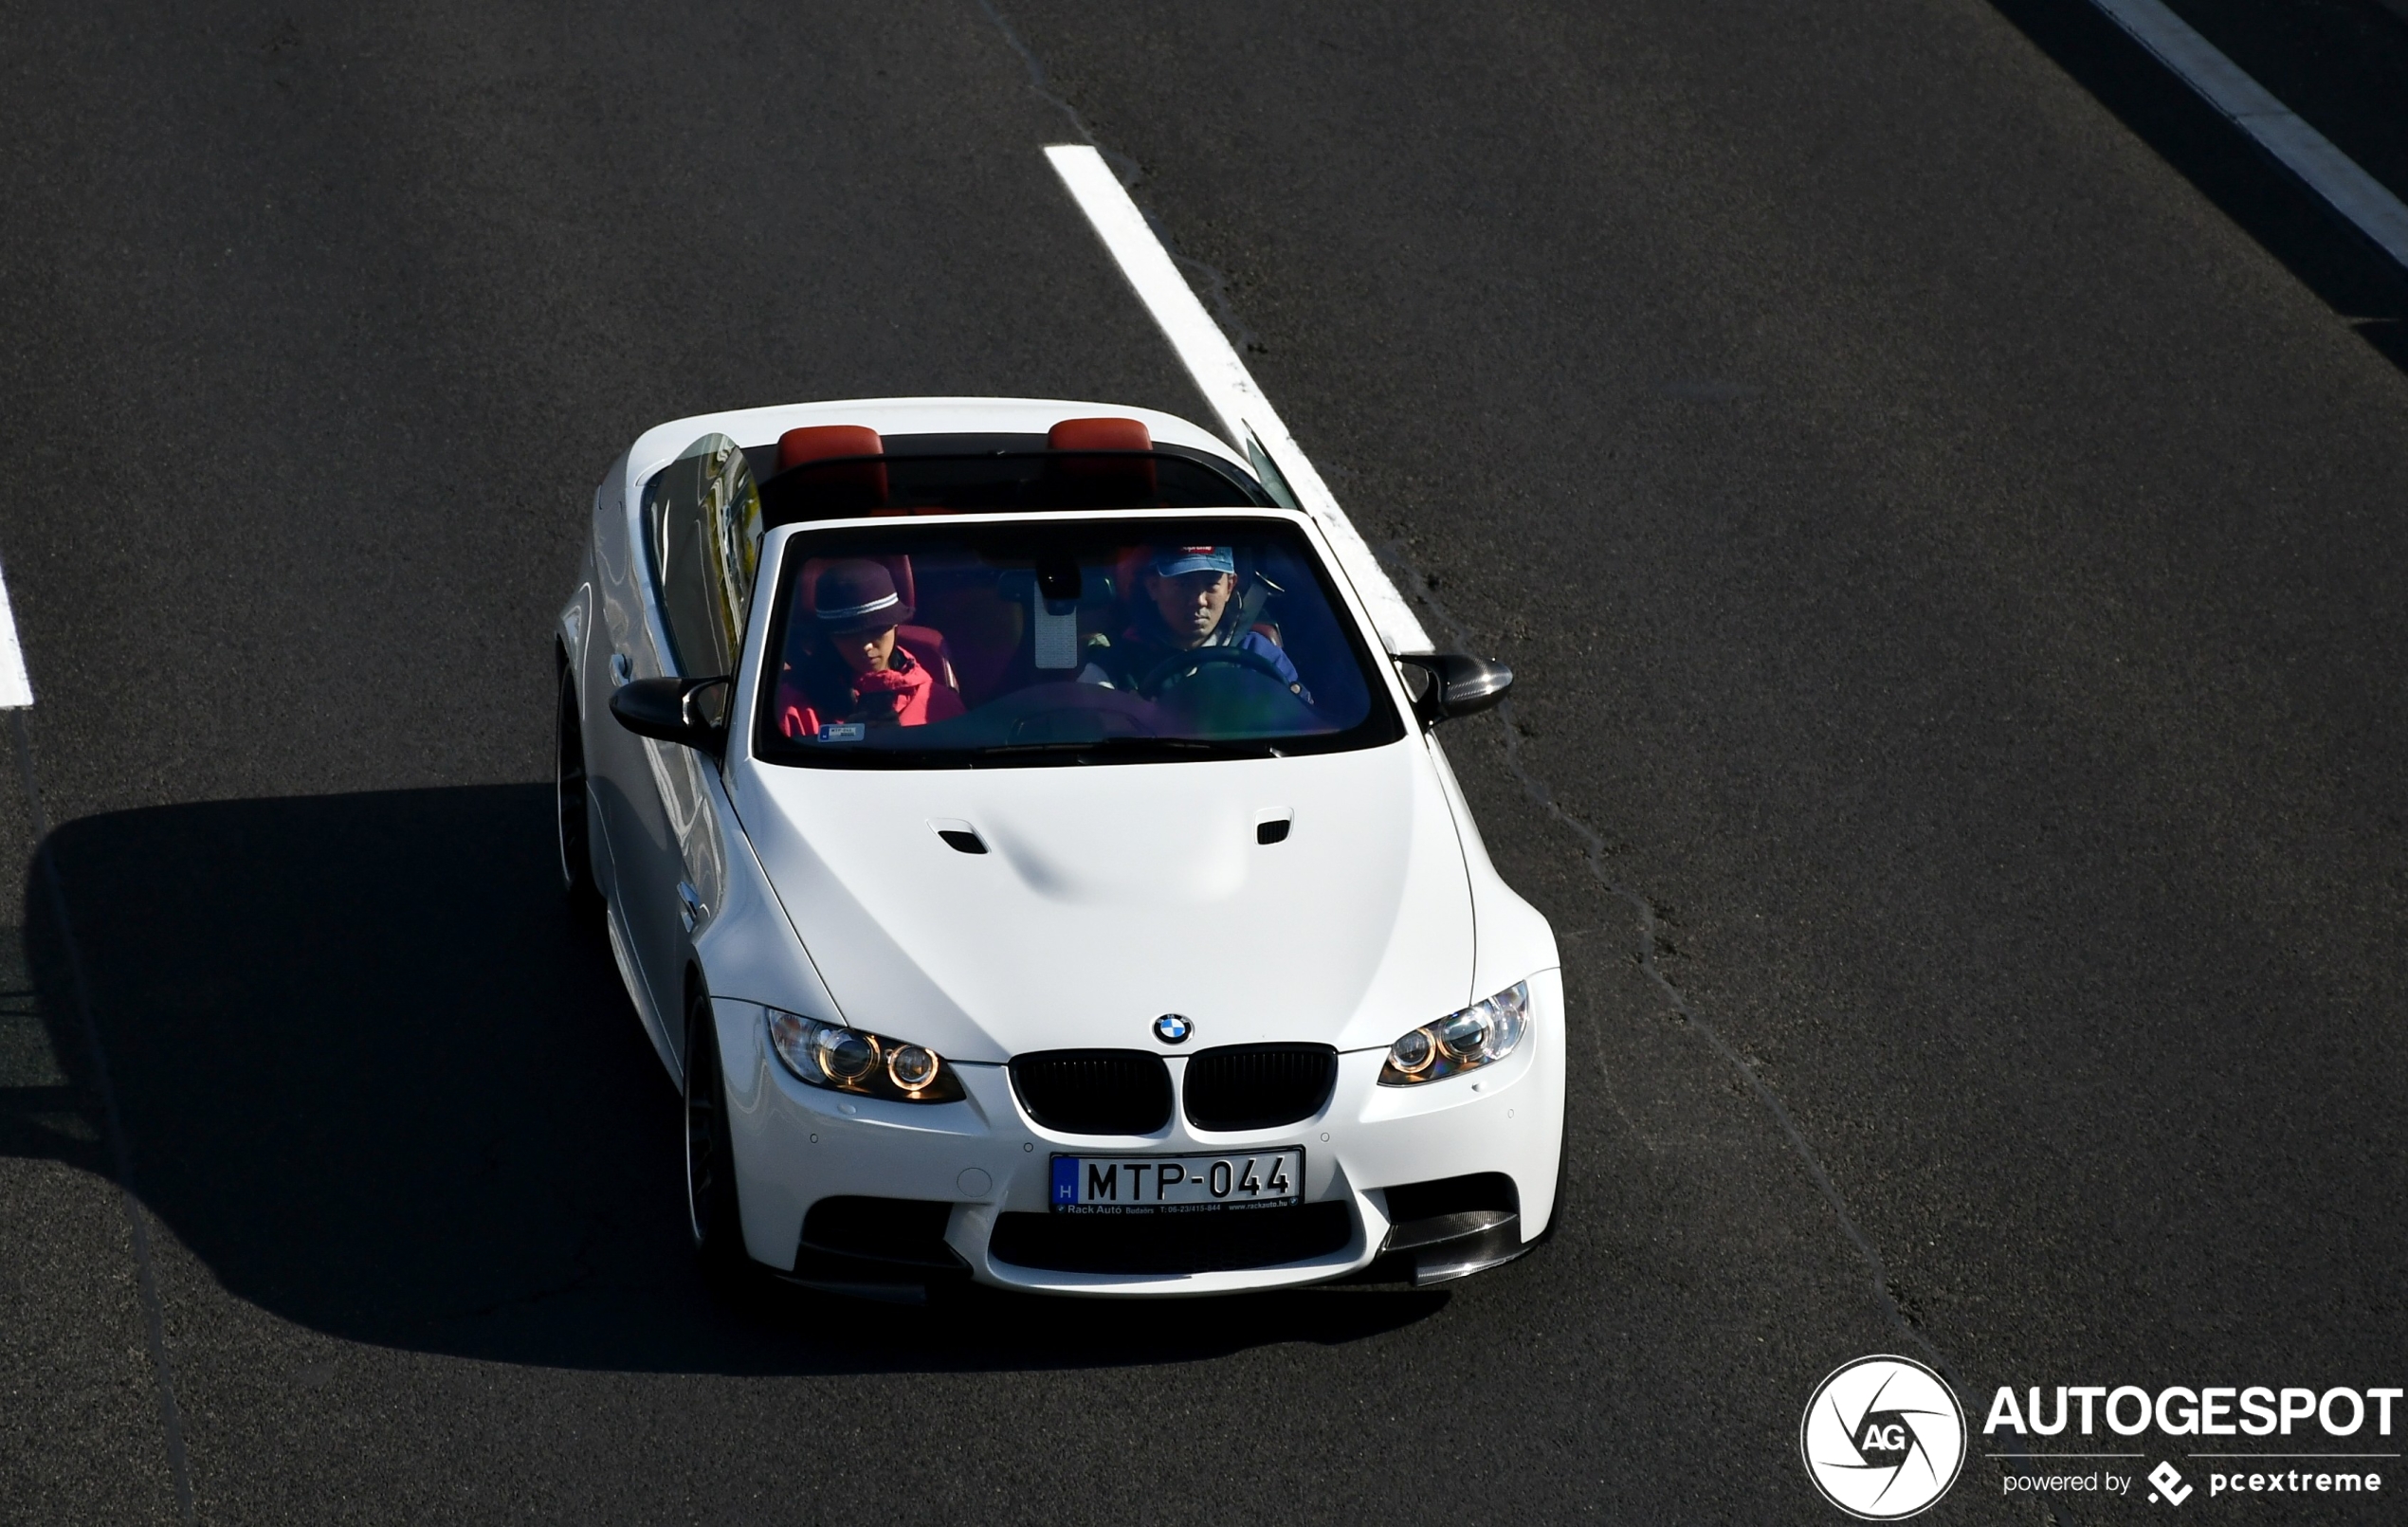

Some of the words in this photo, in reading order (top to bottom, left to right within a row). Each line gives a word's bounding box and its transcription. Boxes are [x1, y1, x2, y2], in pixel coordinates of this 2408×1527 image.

[1087, 1156, 1289, 1201] MTP-044
[1060, 1185, 1071, 1198] H
[1067, 1205, 1094, 1213] Rack
[1096, 1204, 1122, 1214] Autó
[1229, 1200, 1287, 1210] www.rackauto.hu
